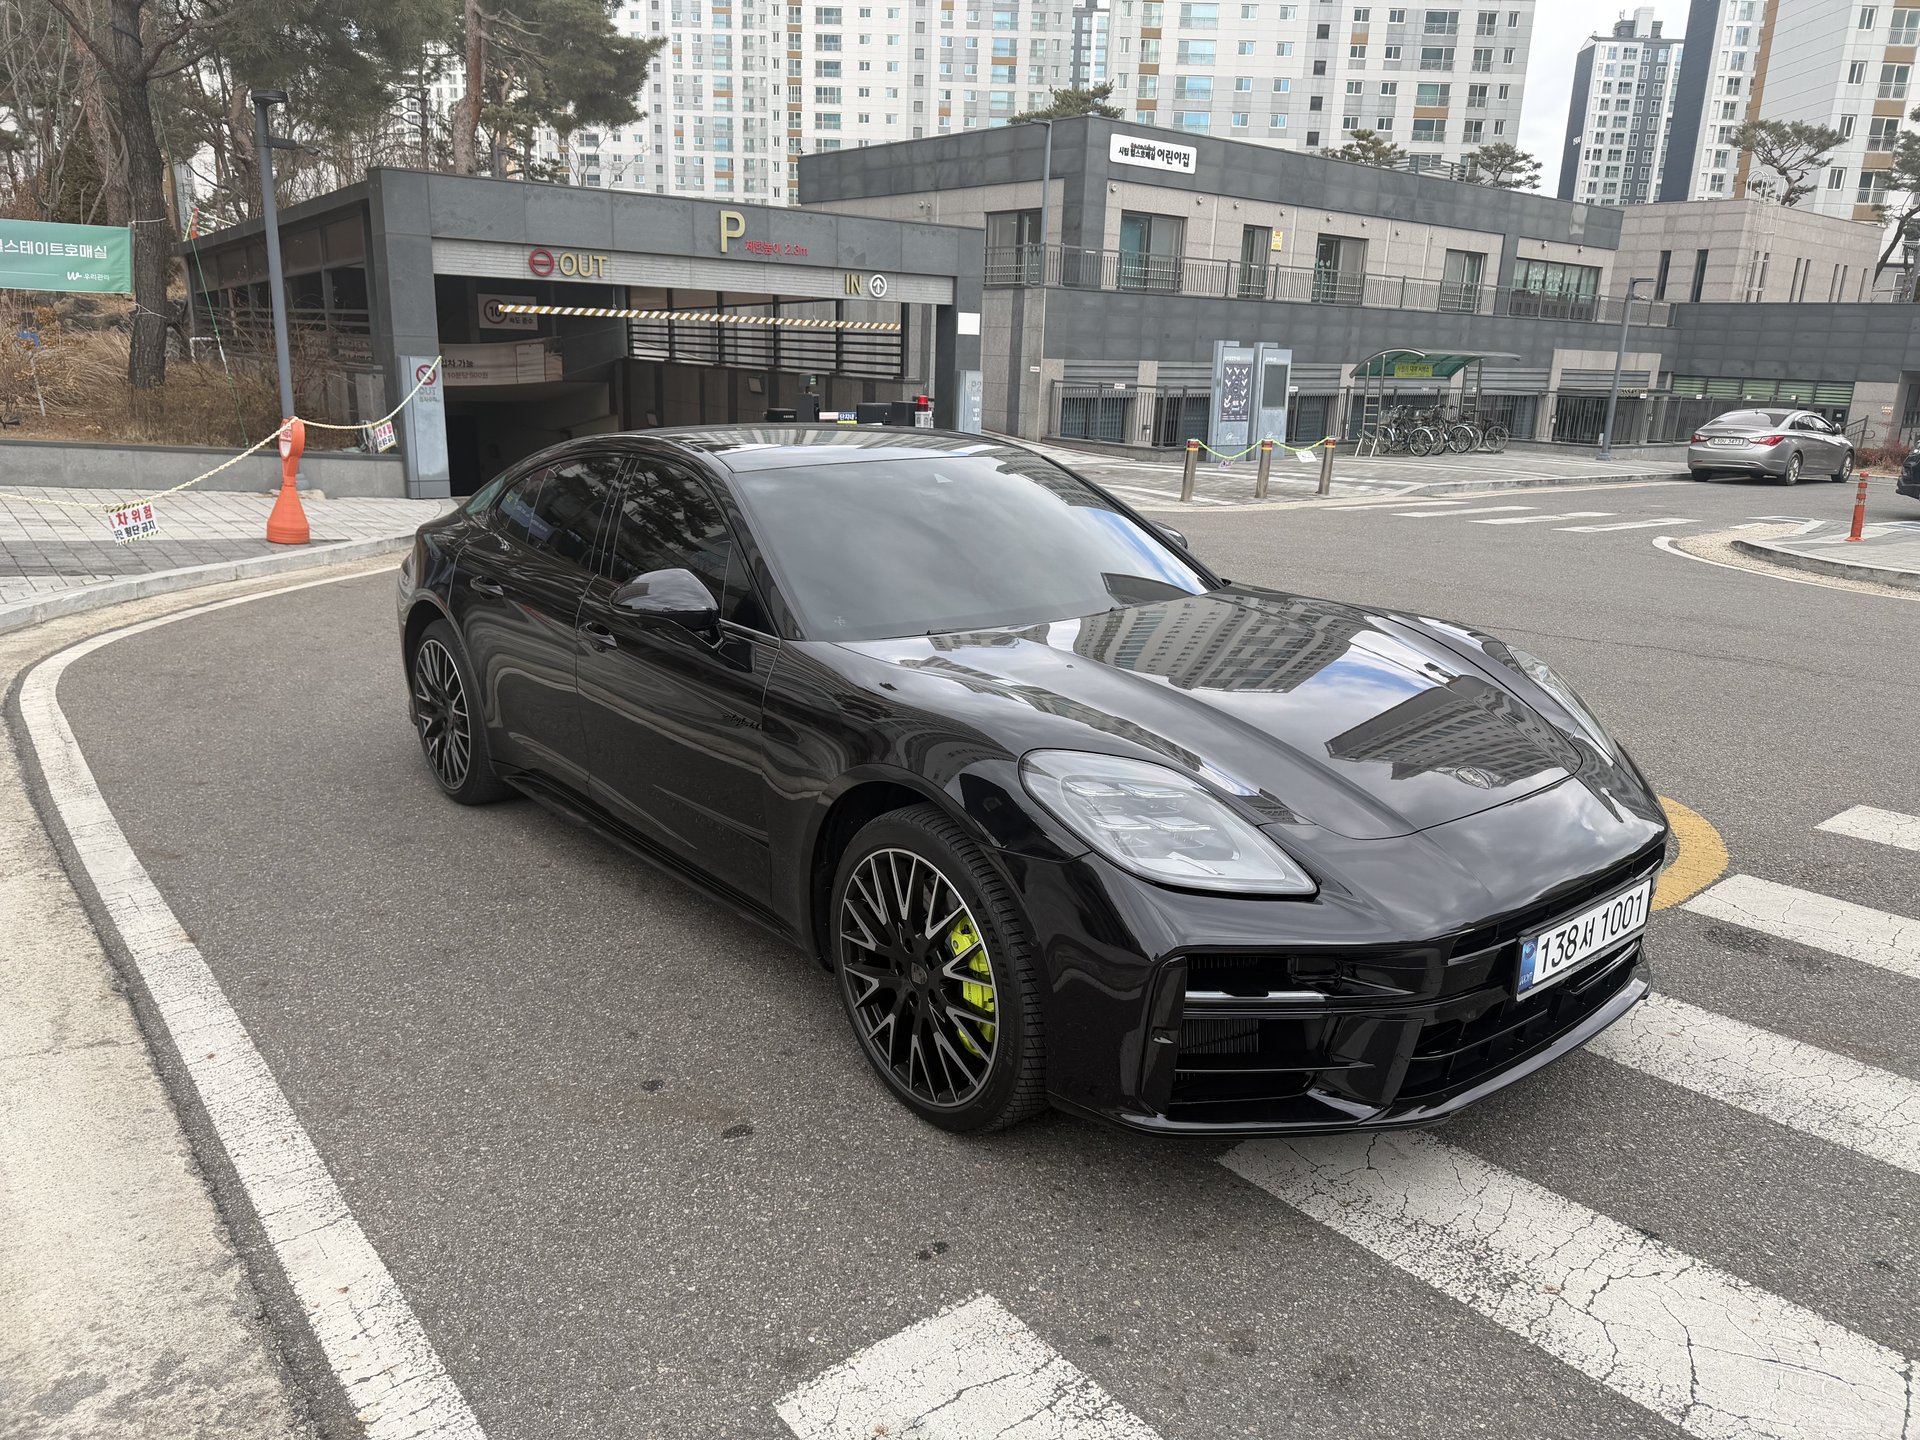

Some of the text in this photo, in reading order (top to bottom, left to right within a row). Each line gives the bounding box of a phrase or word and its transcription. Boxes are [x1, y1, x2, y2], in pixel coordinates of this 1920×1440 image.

[1157, 149, 1190, 168] 어린이집
[720, 210, 746, 253] P
[745, 239, 809, 257] 제한높이 2.3m
[559, 252, 608, 278] OUT
[83, 273, 110, 281] 우리관리
[845, 273, 863, 295] IN
[457, 359, 474, 368] 가능
[141, 520, 156, 533] 금지
[1541, 889, 1644, 974] 138서 1001
